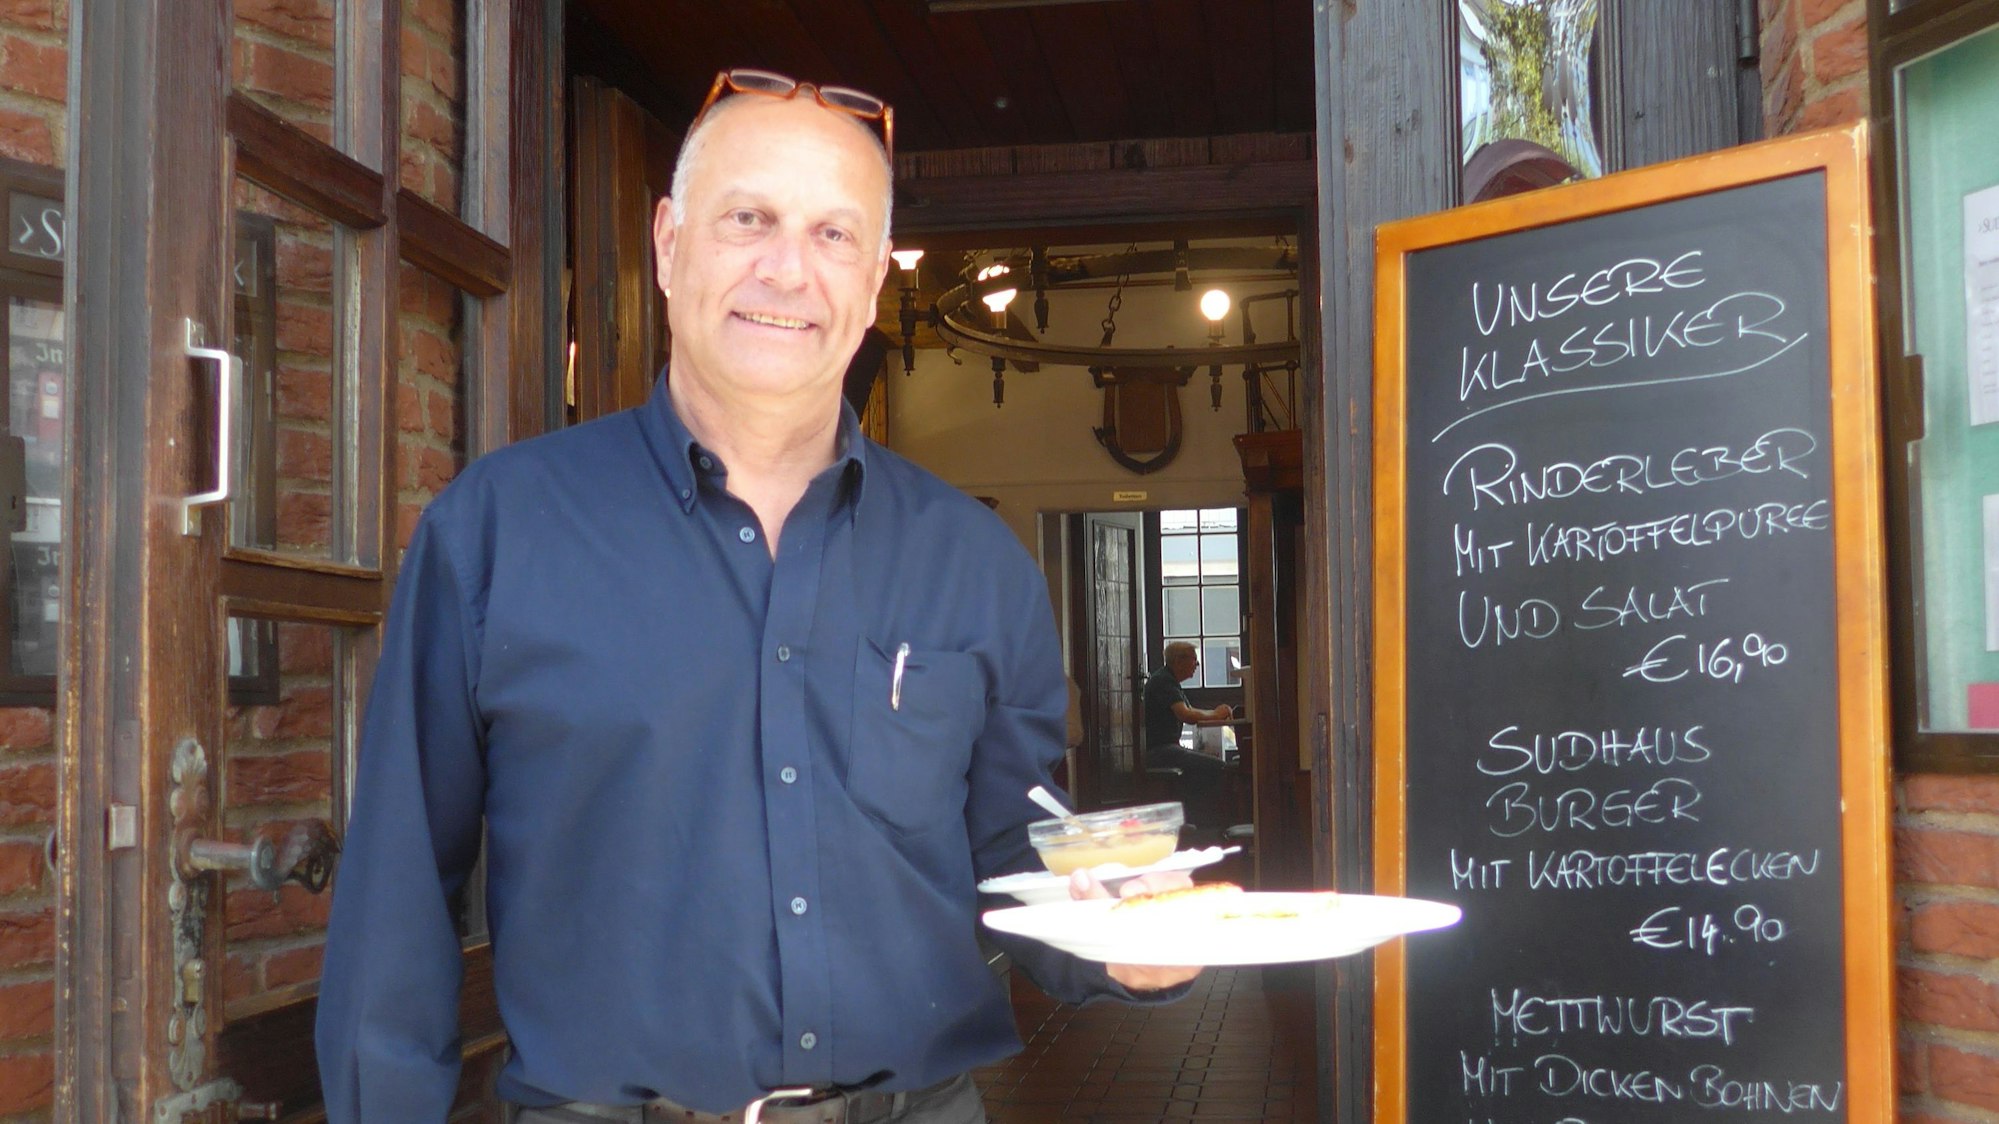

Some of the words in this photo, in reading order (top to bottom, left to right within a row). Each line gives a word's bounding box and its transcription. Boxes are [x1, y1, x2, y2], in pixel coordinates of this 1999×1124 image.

[1473, 251, 1705, 336] UNSERE
[1460, 292, 1787, 401] KLASSIKER
[1443, 428, 1816, 511] RINDERLEBER
[1454, 523, 1514, 576] MIT
[1459, 591, 1559, 648] UND
[1576, 579, 1729, 628] SALAT
[1477, 726, 1711, 775] SUDHAUS
[1486, 777, 1702, 837] BURGER
[1450, 848, 1511, 890] MIT
[1529, 847, 1821, 890] KARTOFFELECKEN
[1491, 988, 1754, 1046] METTWURST
[1460, 1050, 1524, 1096] MIT
[1534, 1054, 1681, 1103] DICKEN
[1690, 1064, 1843, 1112] BOHNEN
